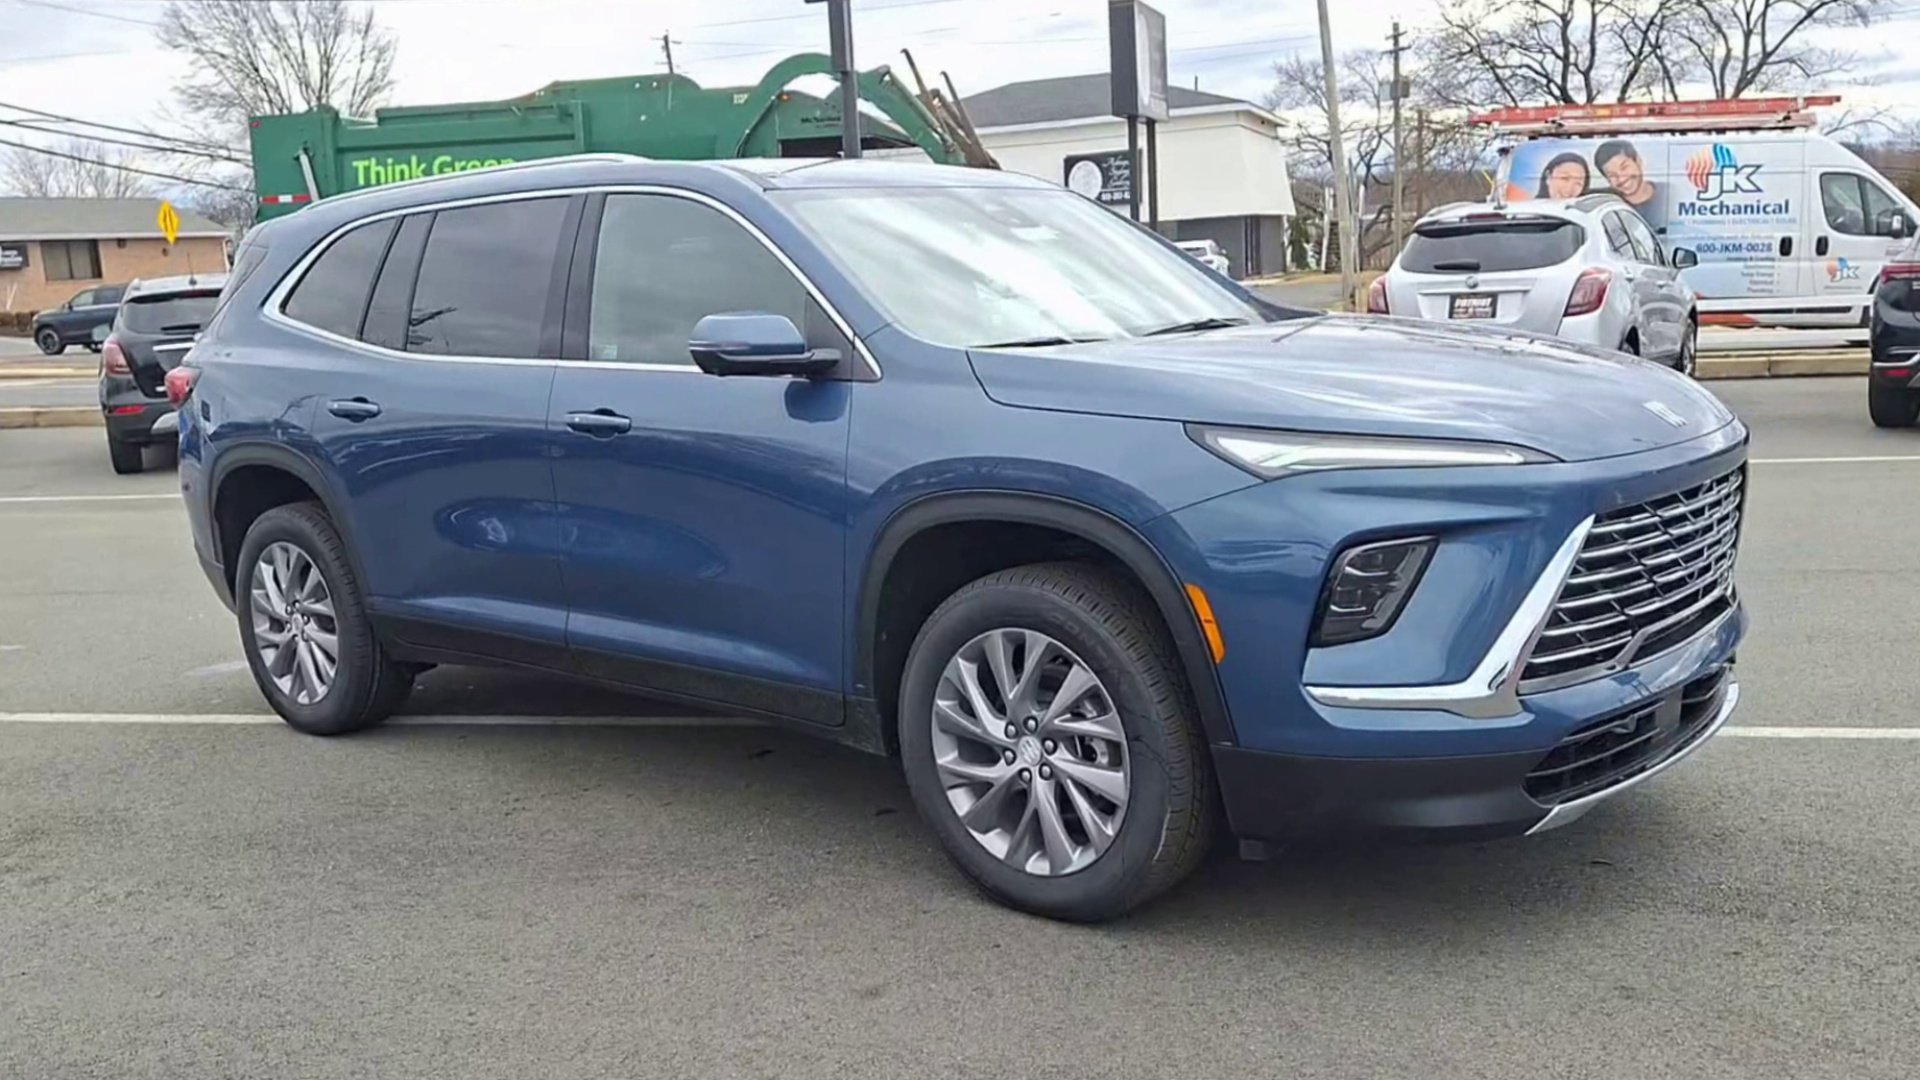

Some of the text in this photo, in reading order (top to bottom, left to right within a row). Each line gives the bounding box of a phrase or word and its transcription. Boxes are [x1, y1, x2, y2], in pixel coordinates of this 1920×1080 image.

[352, 154, 516, 186] Think Gree
[1678, 199, 1790, 217] Mechanical
